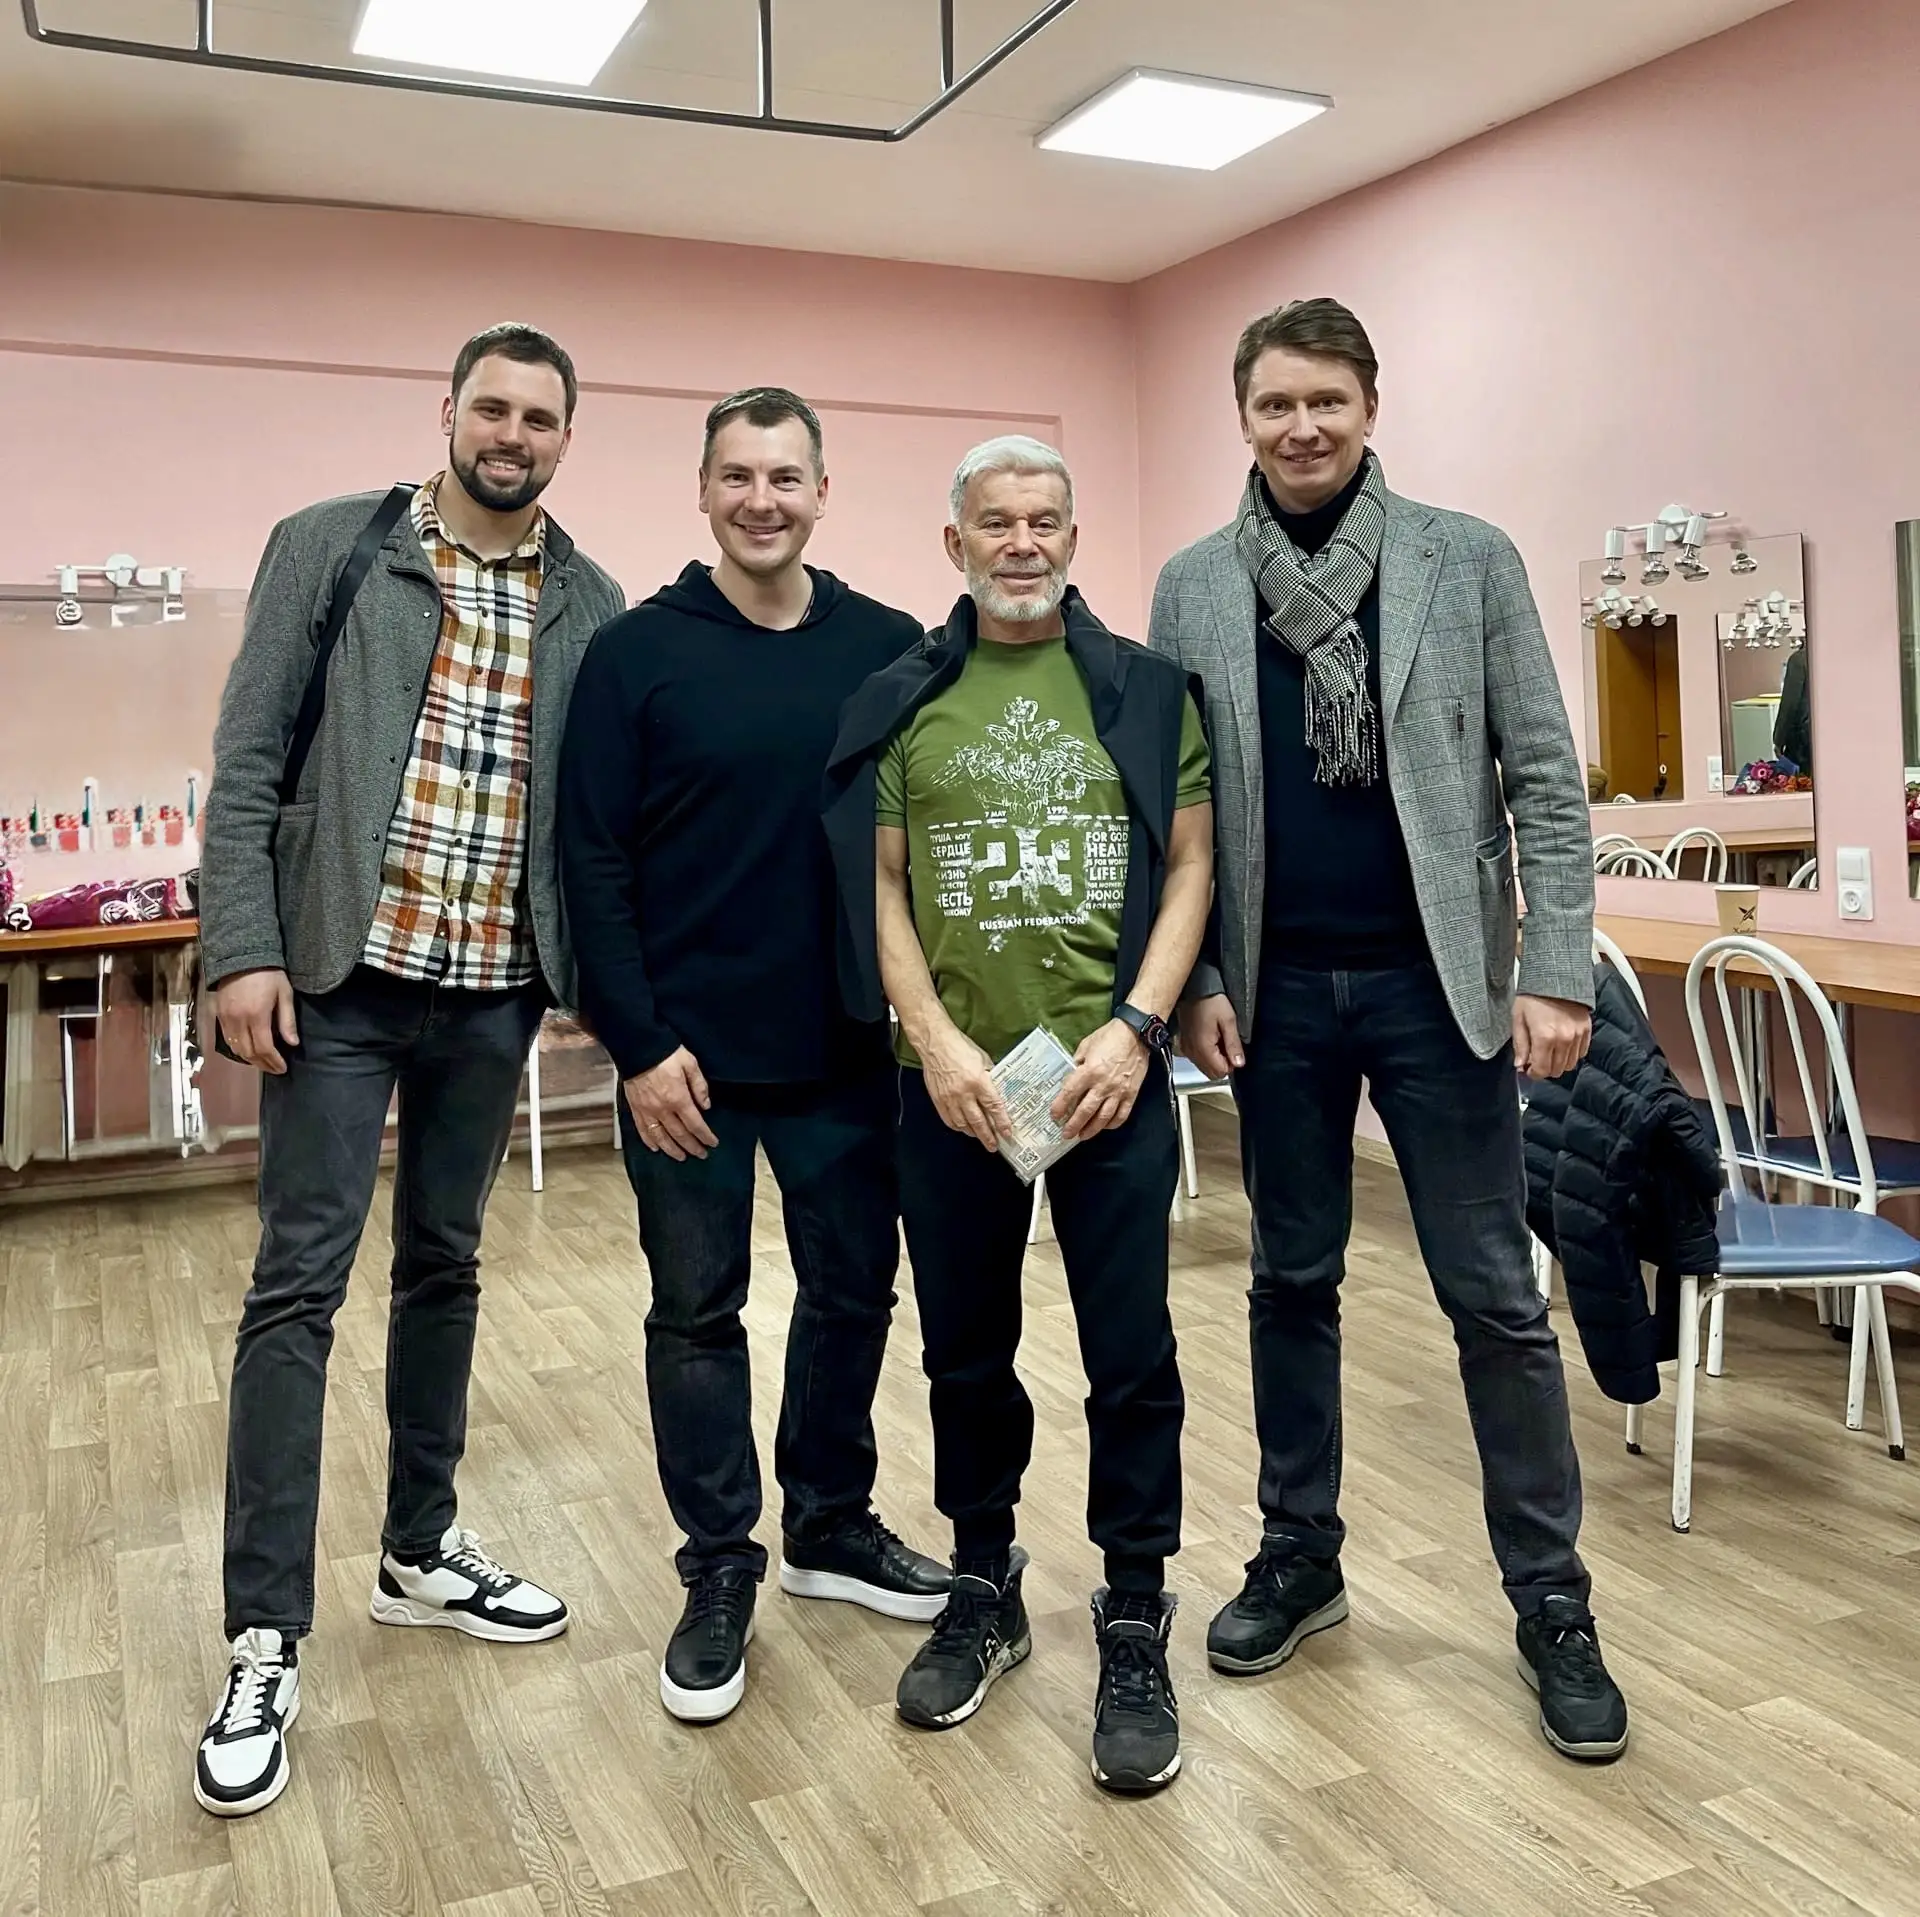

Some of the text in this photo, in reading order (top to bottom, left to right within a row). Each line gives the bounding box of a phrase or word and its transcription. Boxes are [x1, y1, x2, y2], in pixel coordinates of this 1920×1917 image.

[1085, 831, 1128, 842] FOR GOD
[930, 842, 972, 858] СЕРДЦЕ
[1086, 842, 1129, 858] HEART
[1089, 866, 1117, 881] LIFE
[979, 915, 1085, 931] RUSSIAN FEDERATION
